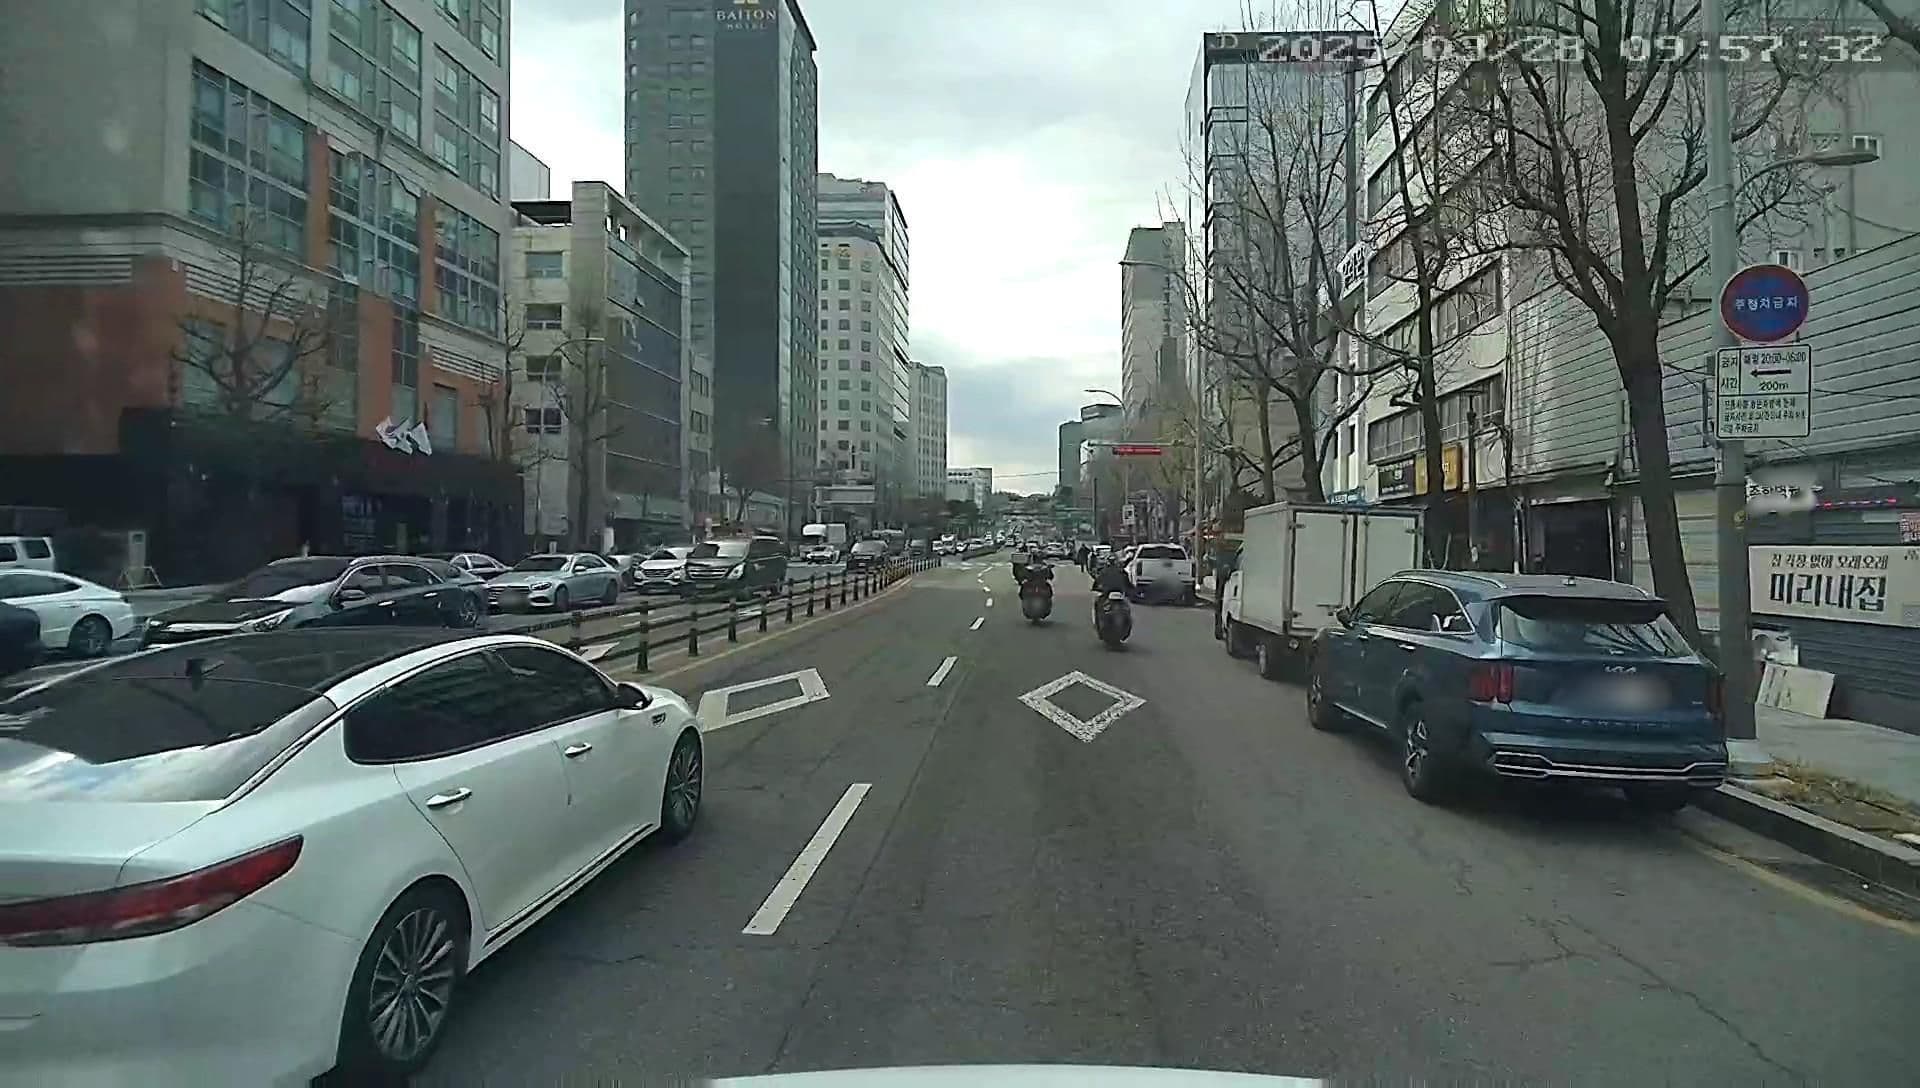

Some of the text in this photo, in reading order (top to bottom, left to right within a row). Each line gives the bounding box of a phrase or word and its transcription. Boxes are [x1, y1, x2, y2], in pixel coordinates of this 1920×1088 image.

[716, 8, 776, 21] BAITON
[1735, 295, 1799, 311] 주정차금지
[1721, 377, 1738, 389] 시간
[1758, 380, 1789, 391] 200m
[1810, 554, 1834, 569] 없이
[1837, 554, 1889, 570] 오래오래
[1770, 573, 1887, 612] 미리내집
